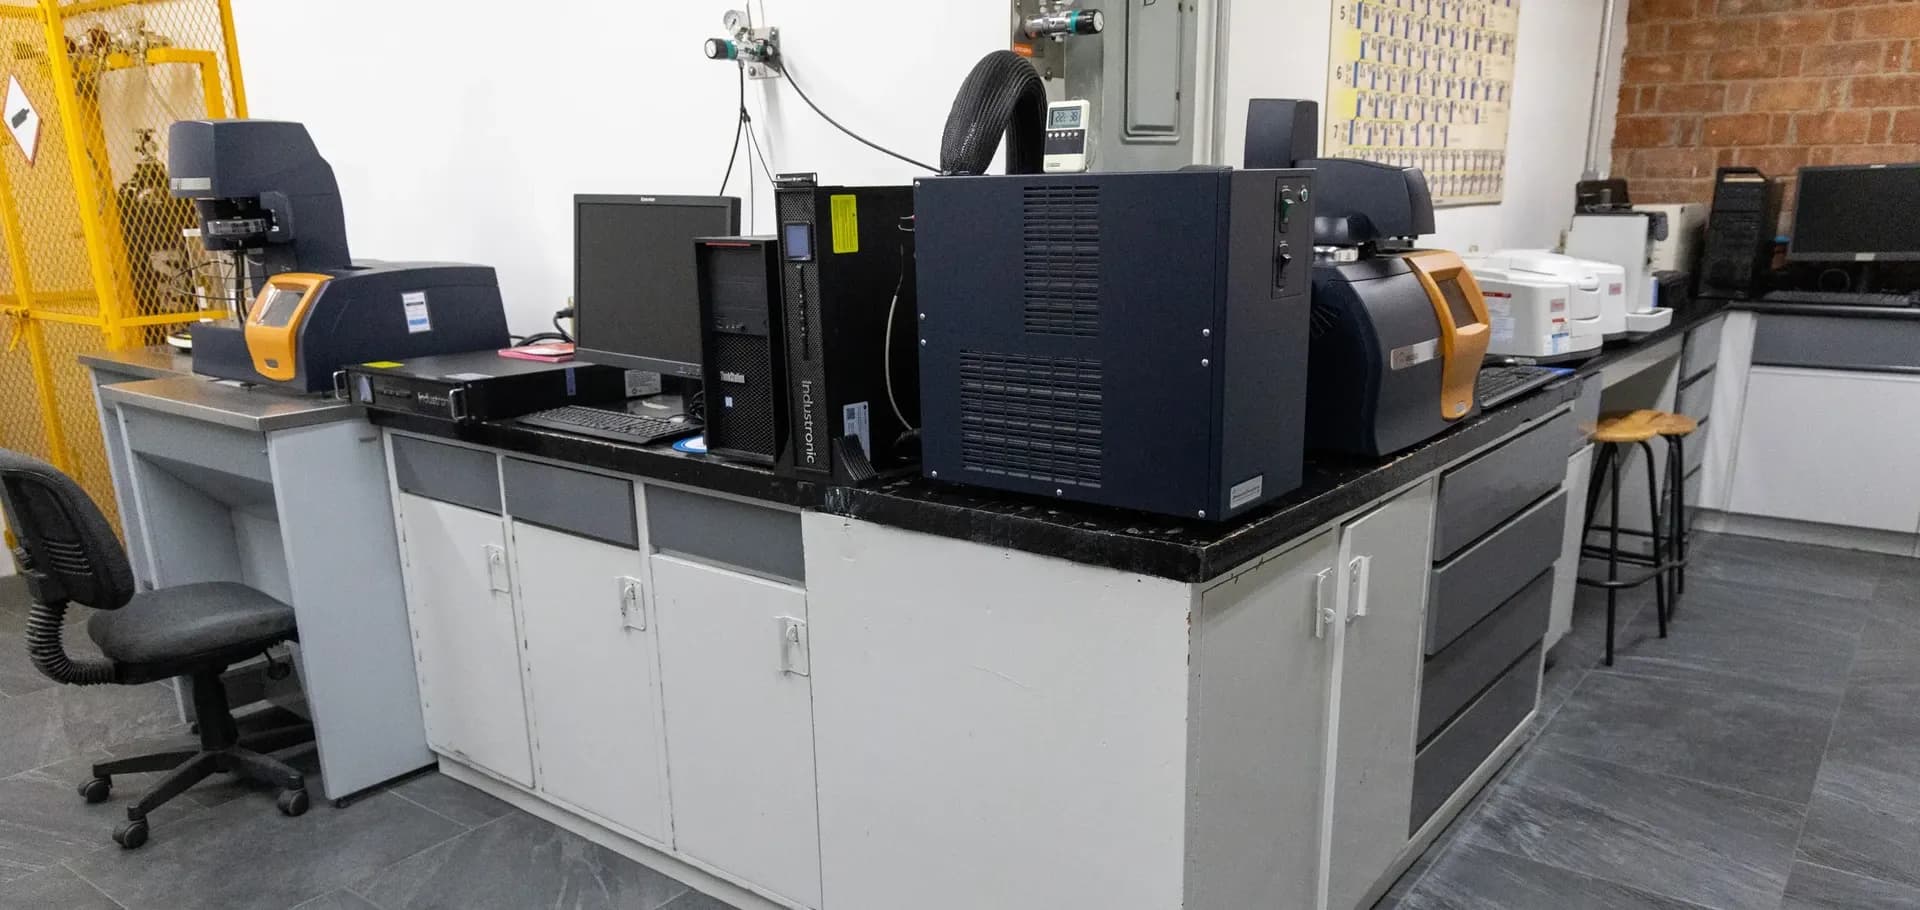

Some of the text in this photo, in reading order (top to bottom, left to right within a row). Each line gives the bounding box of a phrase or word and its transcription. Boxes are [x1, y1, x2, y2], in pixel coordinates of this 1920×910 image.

[1340, 6, 1346, 20] 5
[1336, 65, 1342, 80] 6
[1333, 124, 1339, 139] 7
[801, 380, 817, 464] Industronic
